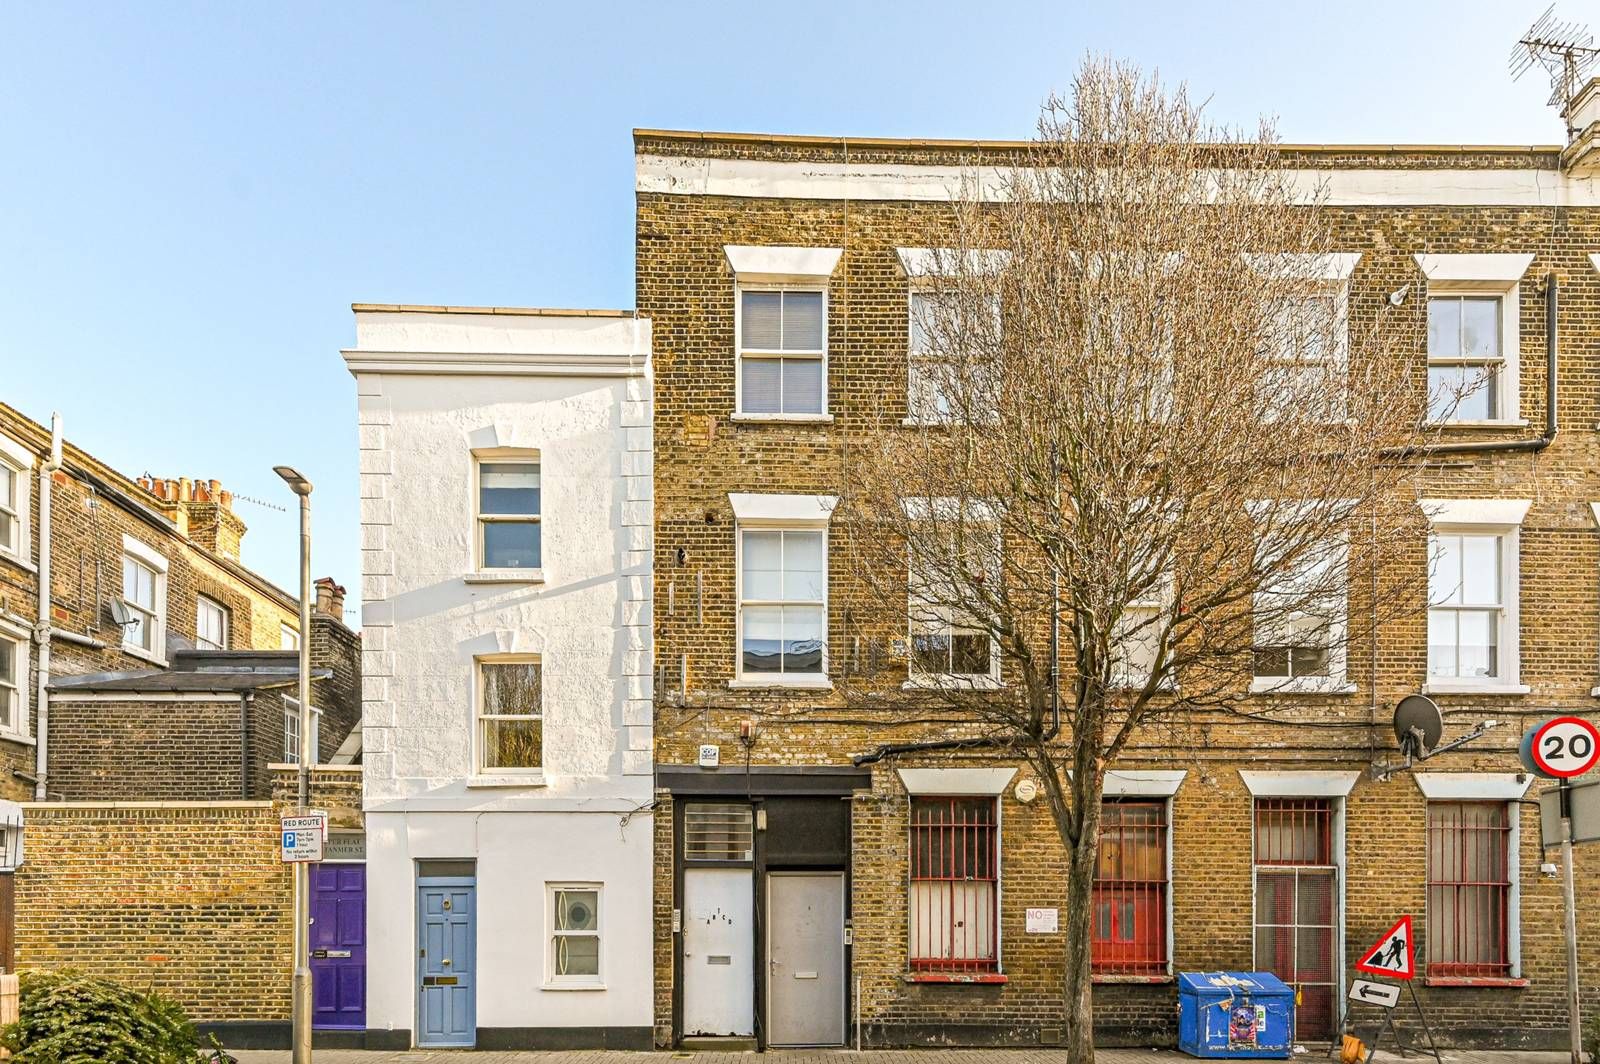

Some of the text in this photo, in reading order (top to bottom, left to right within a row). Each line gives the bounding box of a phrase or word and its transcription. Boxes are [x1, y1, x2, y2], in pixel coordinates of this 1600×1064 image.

[1544, 734, 1592, 760] 20
[298, 818, 320, 826] ROUTE
[1027, 910, 1043, 920] NO
